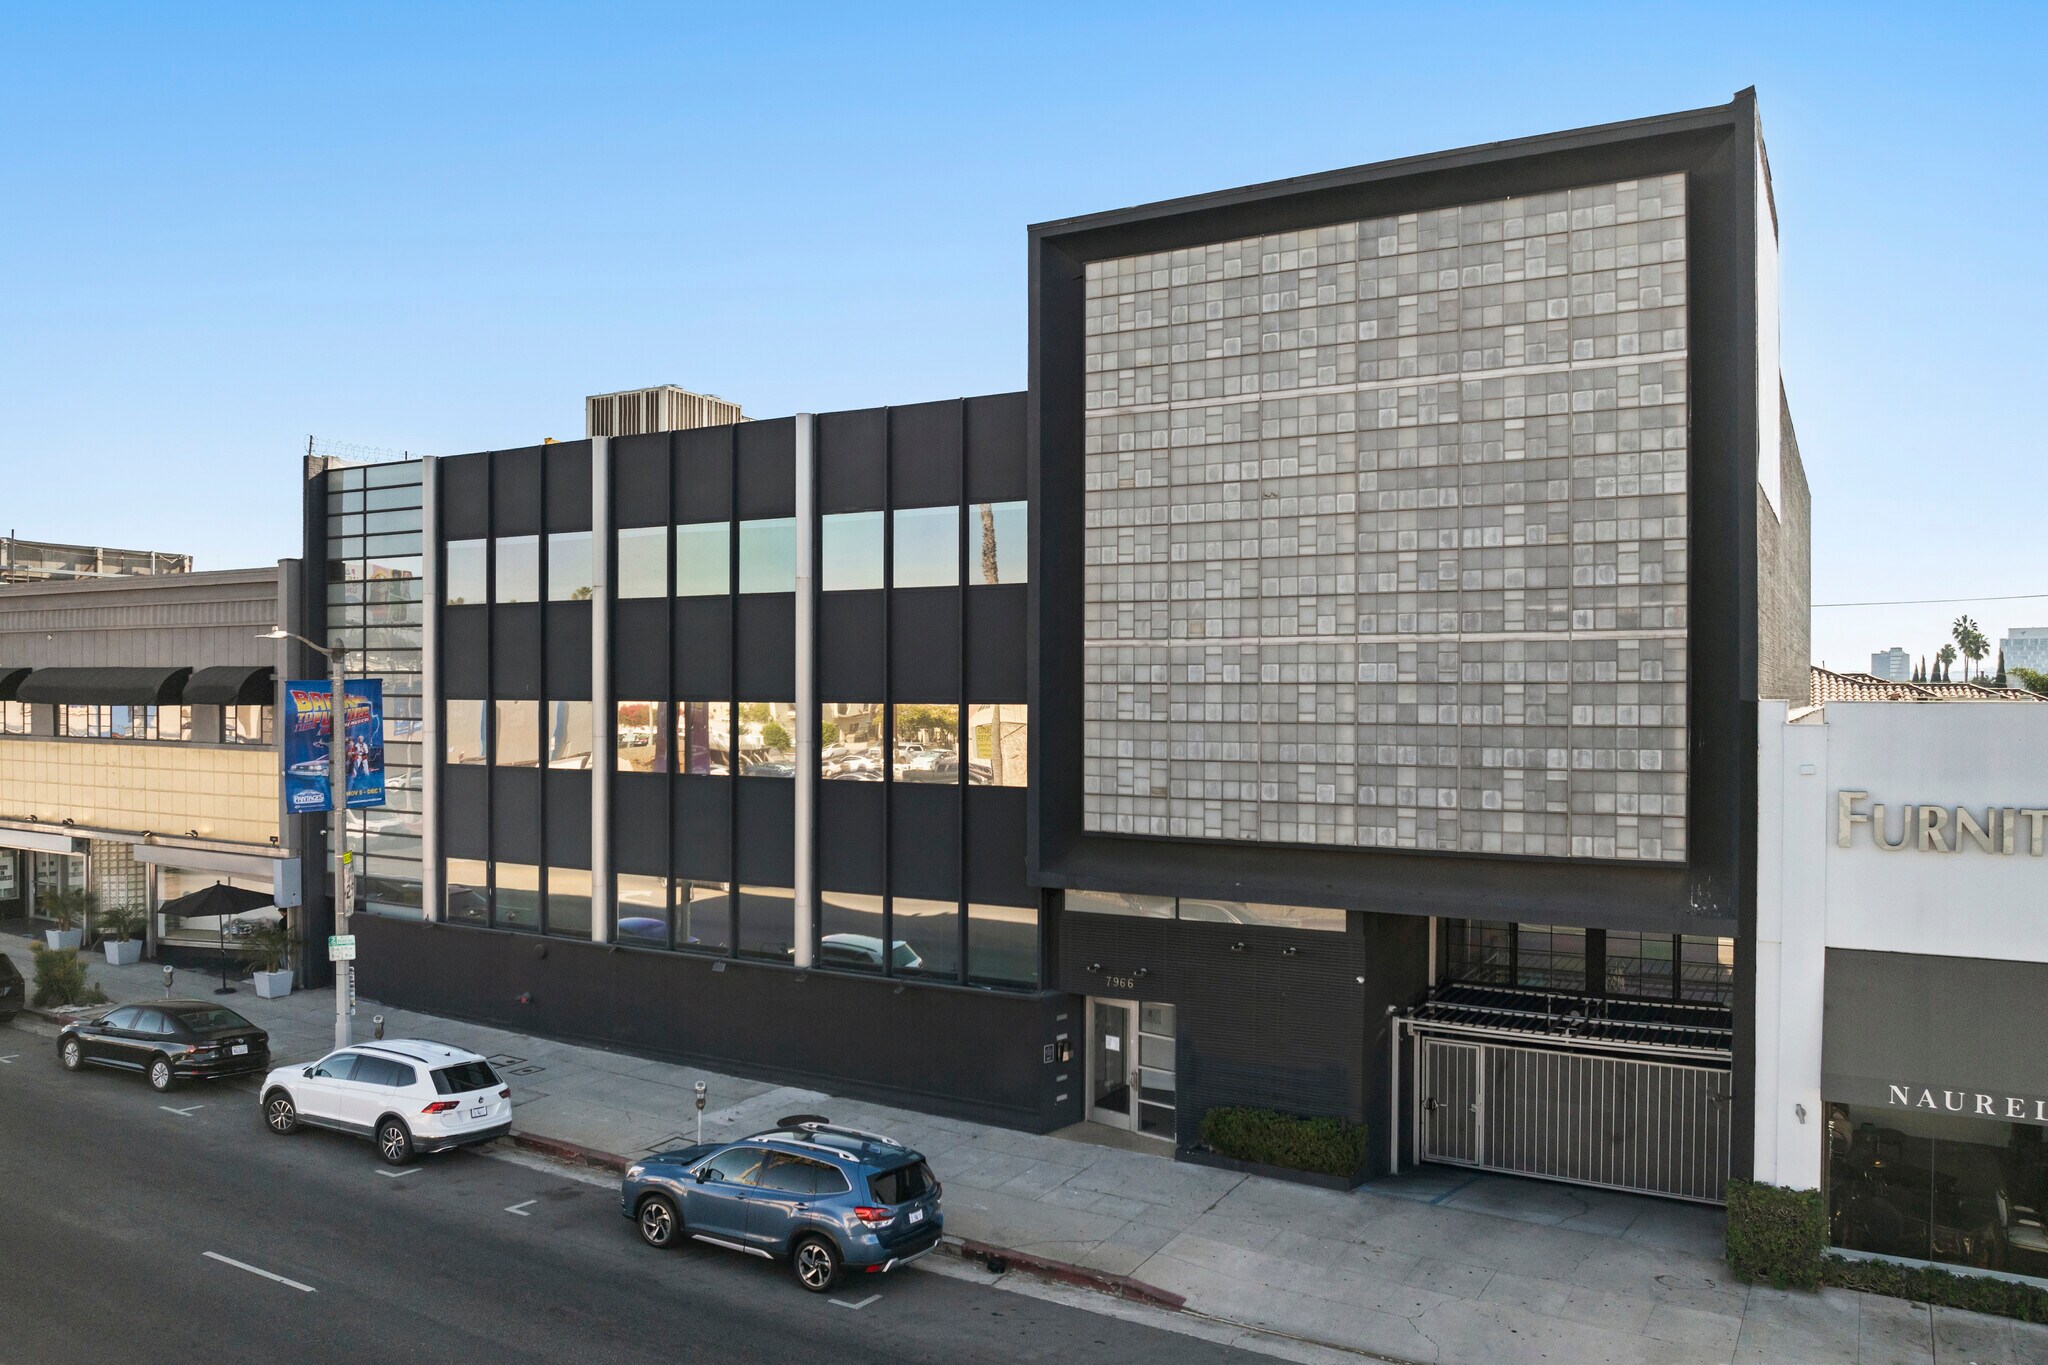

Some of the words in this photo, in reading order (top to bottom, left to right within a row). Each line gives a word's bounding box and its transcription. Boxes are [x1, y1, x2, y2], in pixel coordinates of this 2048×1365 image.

[297, 713, 313, 723] TO
[312, 706, 370, 729] FUURE
[294, 793, 325, 803] PANTAGES
[1838, 790, 2048, 857] FURNIT
[1106, 976, 1134, 989] 7966
[1888, 1084, 2048, 1121] NAUREL
